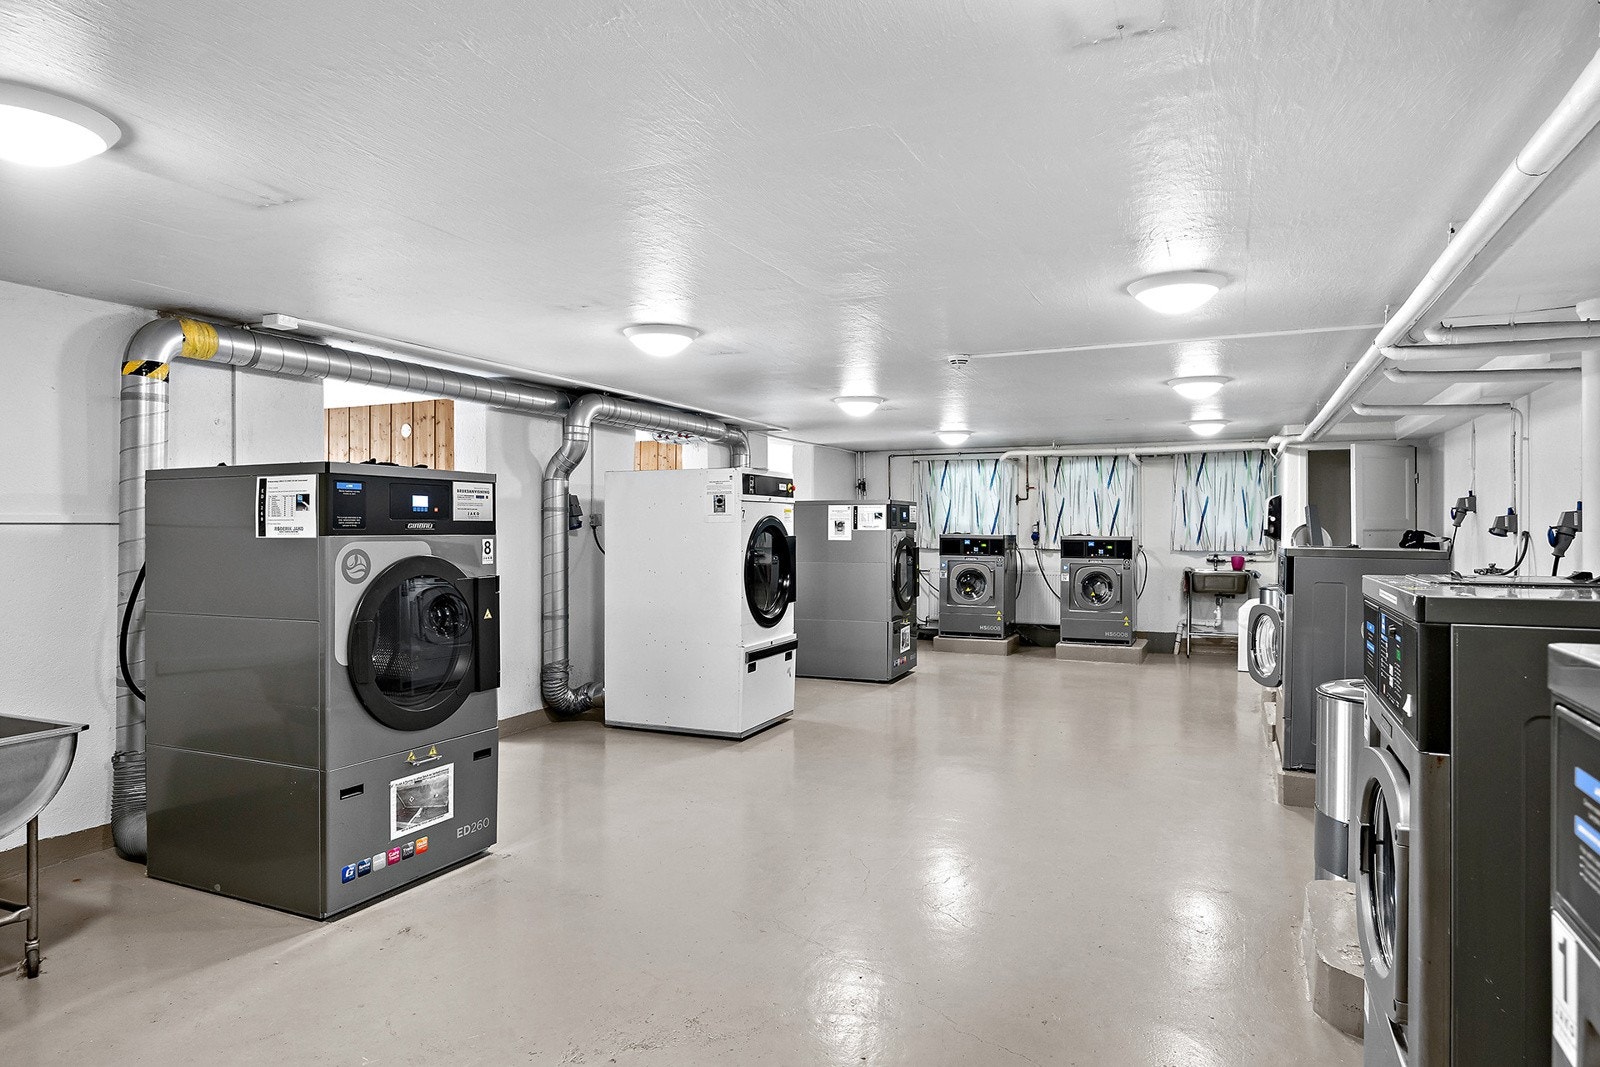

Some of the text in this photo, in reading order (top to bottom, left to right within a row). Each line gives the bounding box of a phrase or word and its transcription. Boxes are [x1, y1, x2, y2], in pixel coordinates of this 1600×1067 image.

[484, 540, 491, 555] 8
[456, 817, 490, 839] ED260
[1558, 937, 1568, 1004] 1
